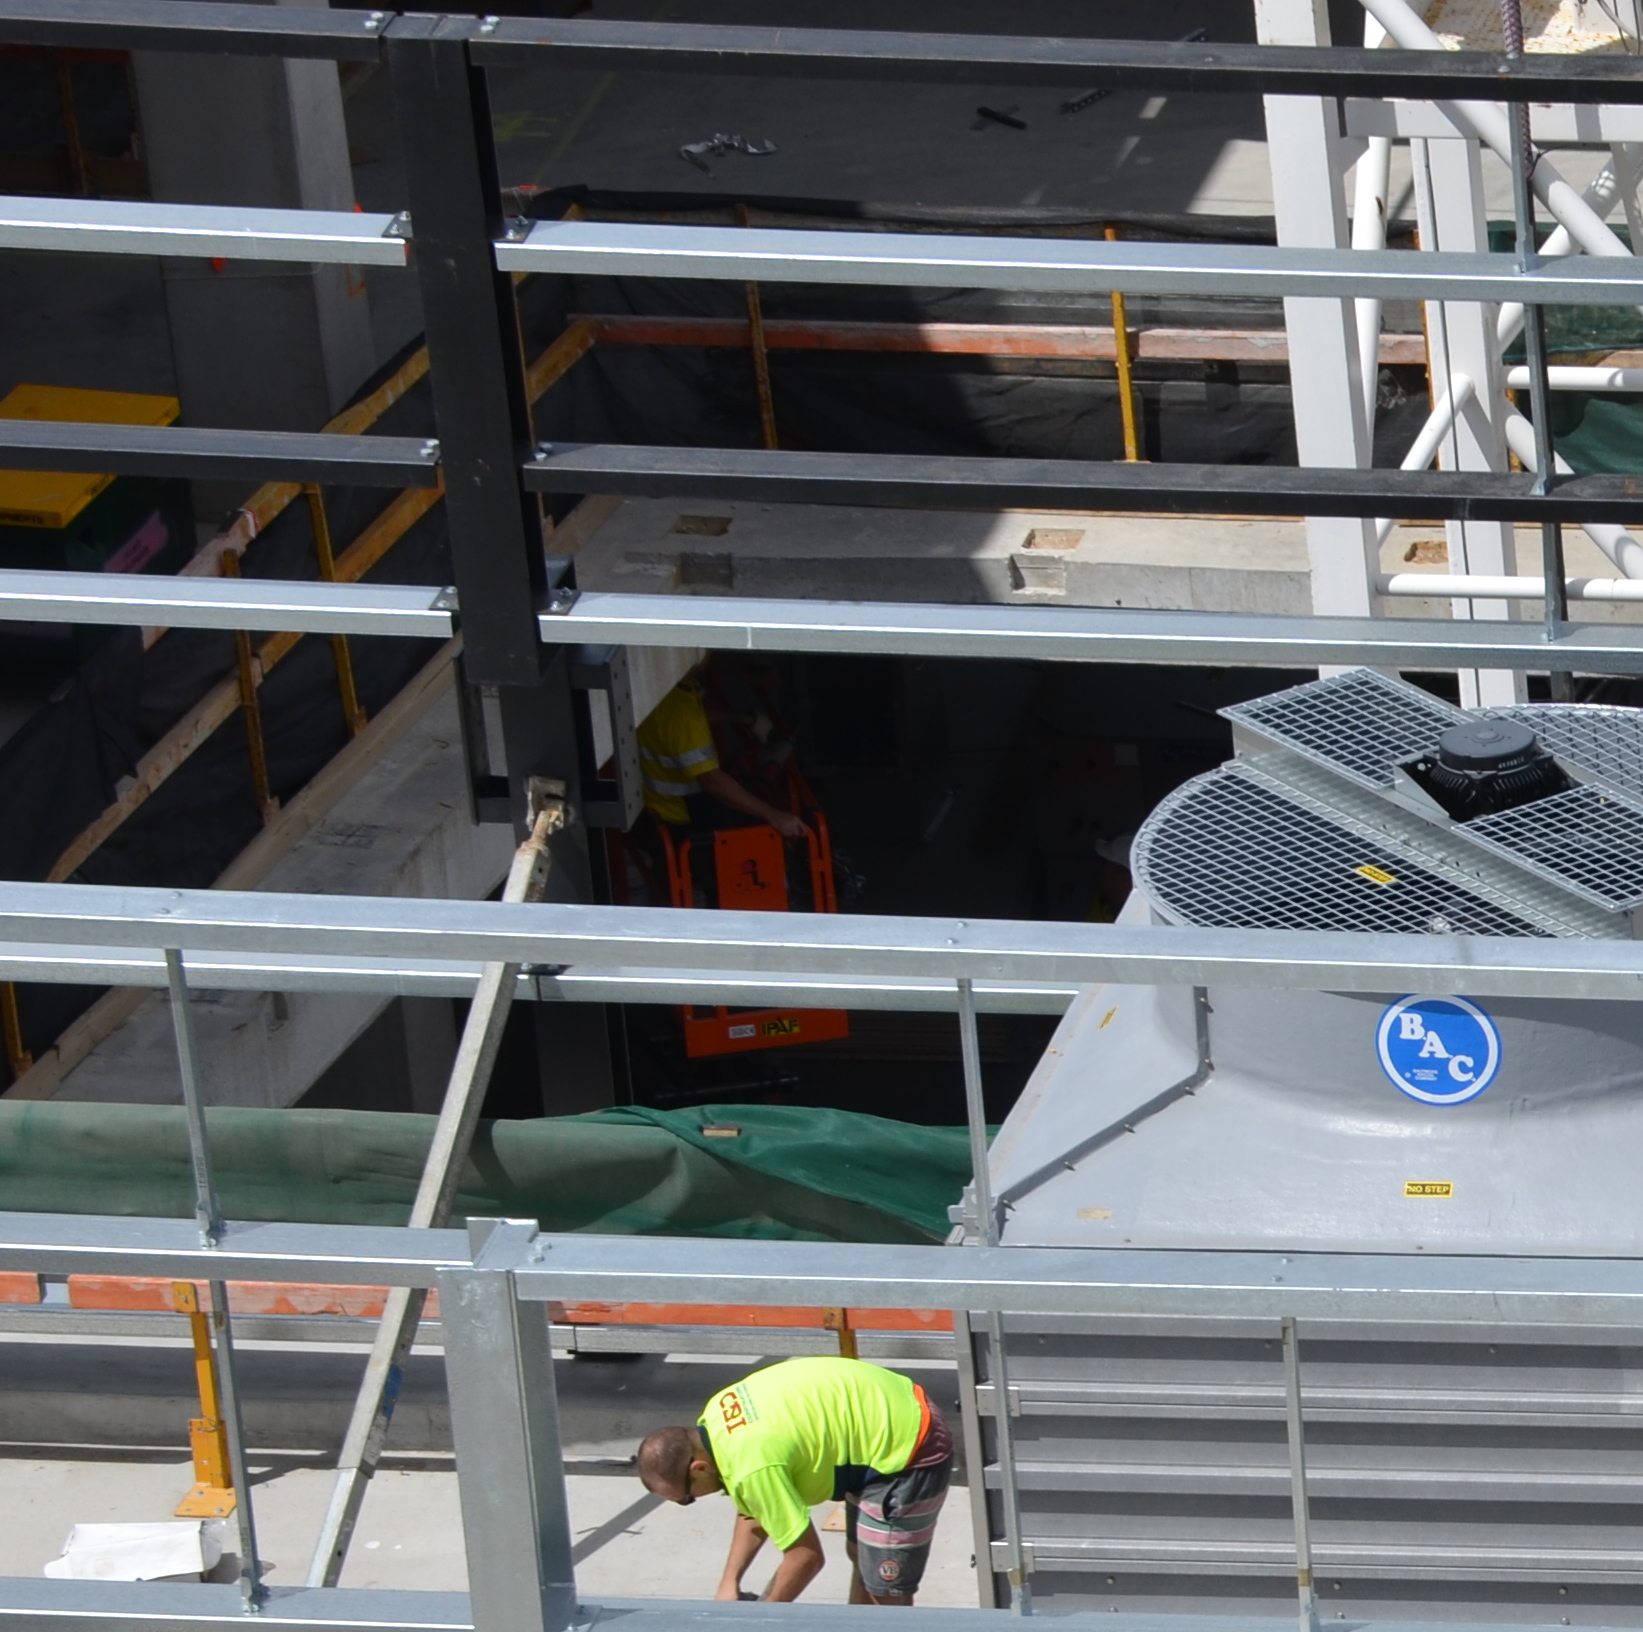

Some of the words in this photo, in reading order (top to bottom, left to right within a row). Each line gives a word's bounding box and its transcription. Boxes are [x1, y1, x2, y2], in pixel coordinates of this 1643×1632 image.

[762, 1018, 800, 1035] IPAF
[1408, 1185, 1423, 1193] NO
[1424, 1185, 1450, 1193] STEP
